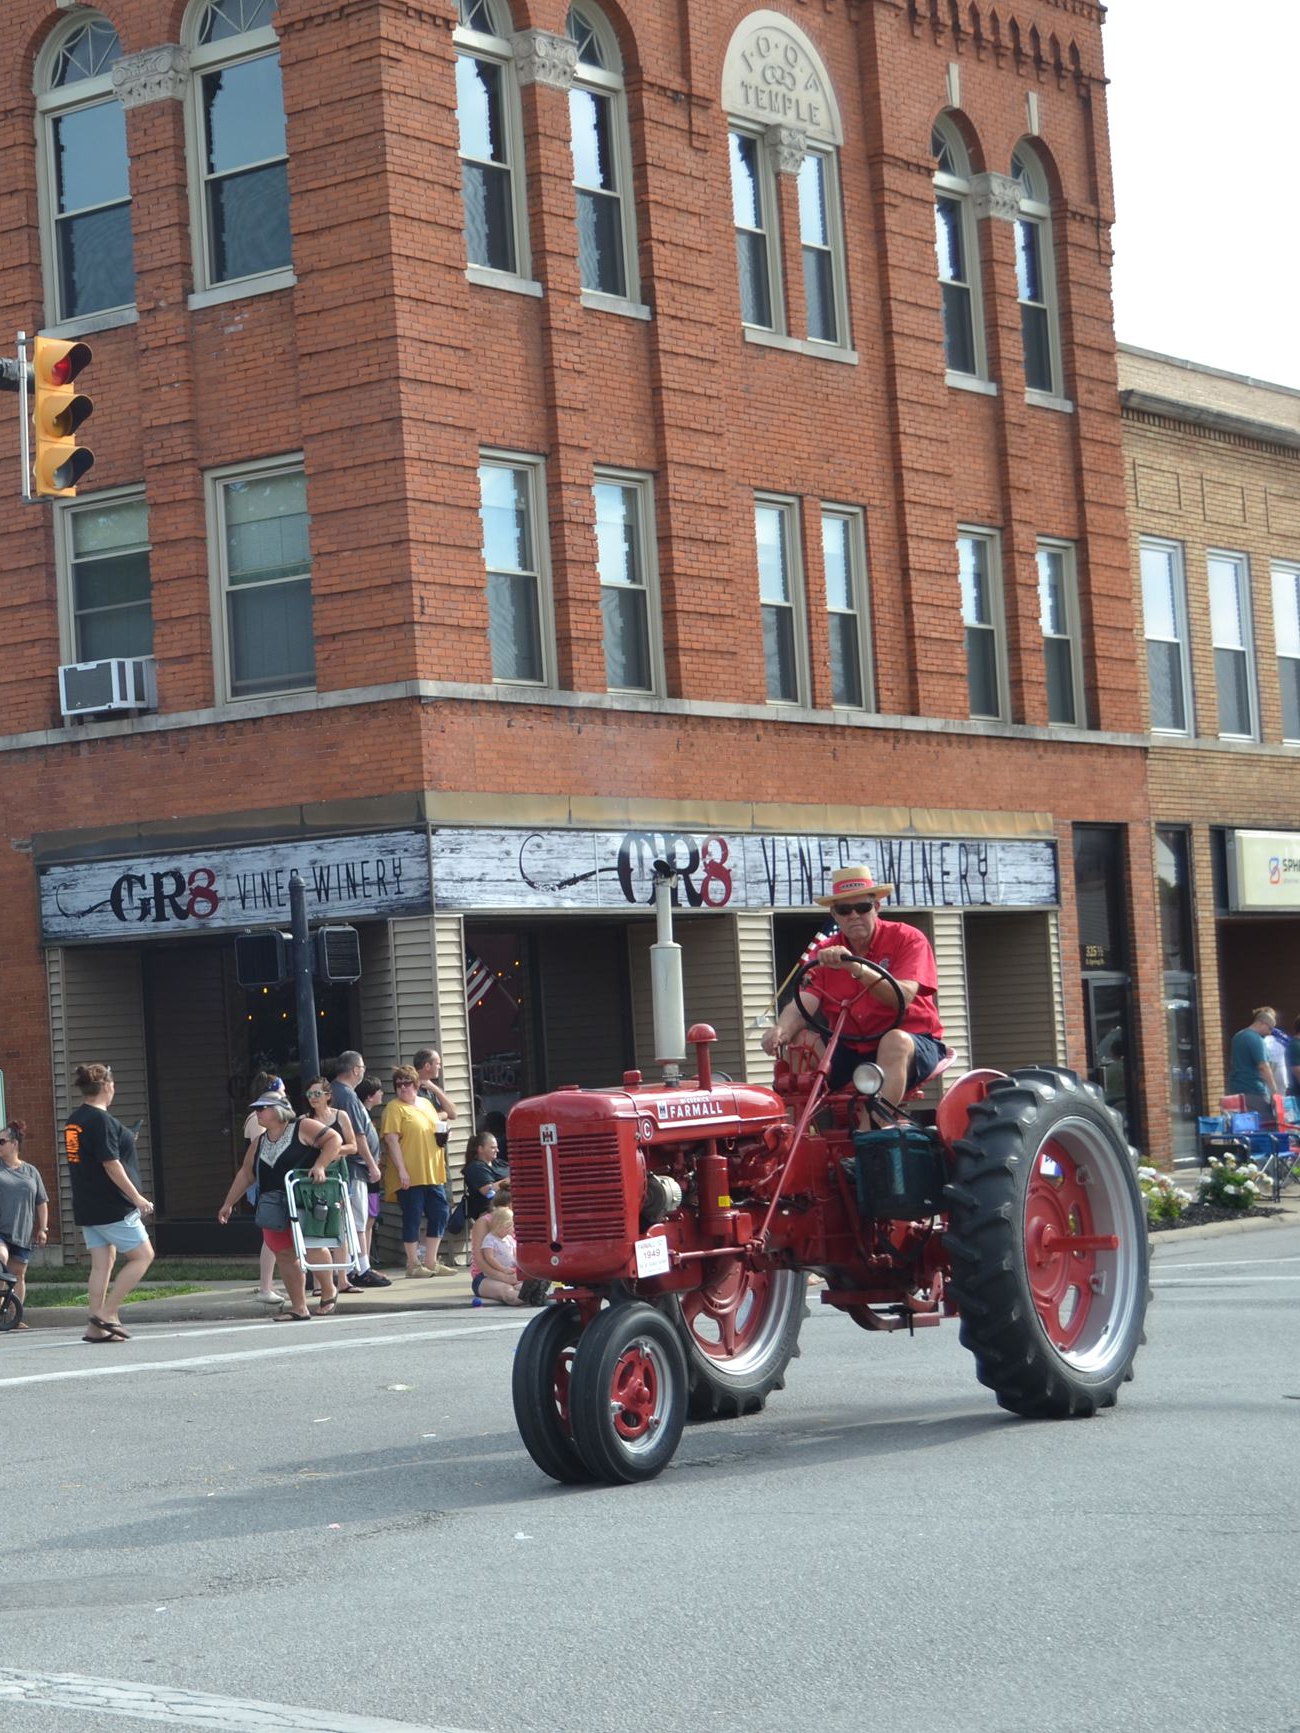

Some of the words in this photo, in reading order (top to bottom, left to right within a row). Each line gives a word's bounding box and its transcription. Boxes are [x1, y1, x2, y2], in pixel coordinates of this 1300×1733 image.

[741, 80, 821, 126] TEMPLE
[110, 867, 220, 922] GR8
[236, 868, 299, 910] VINE
[312, 857, 404, 903] WINERY
[617, 832, 732, 908] GR8
[880, 840, 992, 906] WINERY
[643, 1122, 651, 1138] C
[669, 1101, 724, 1119] FARMALL
